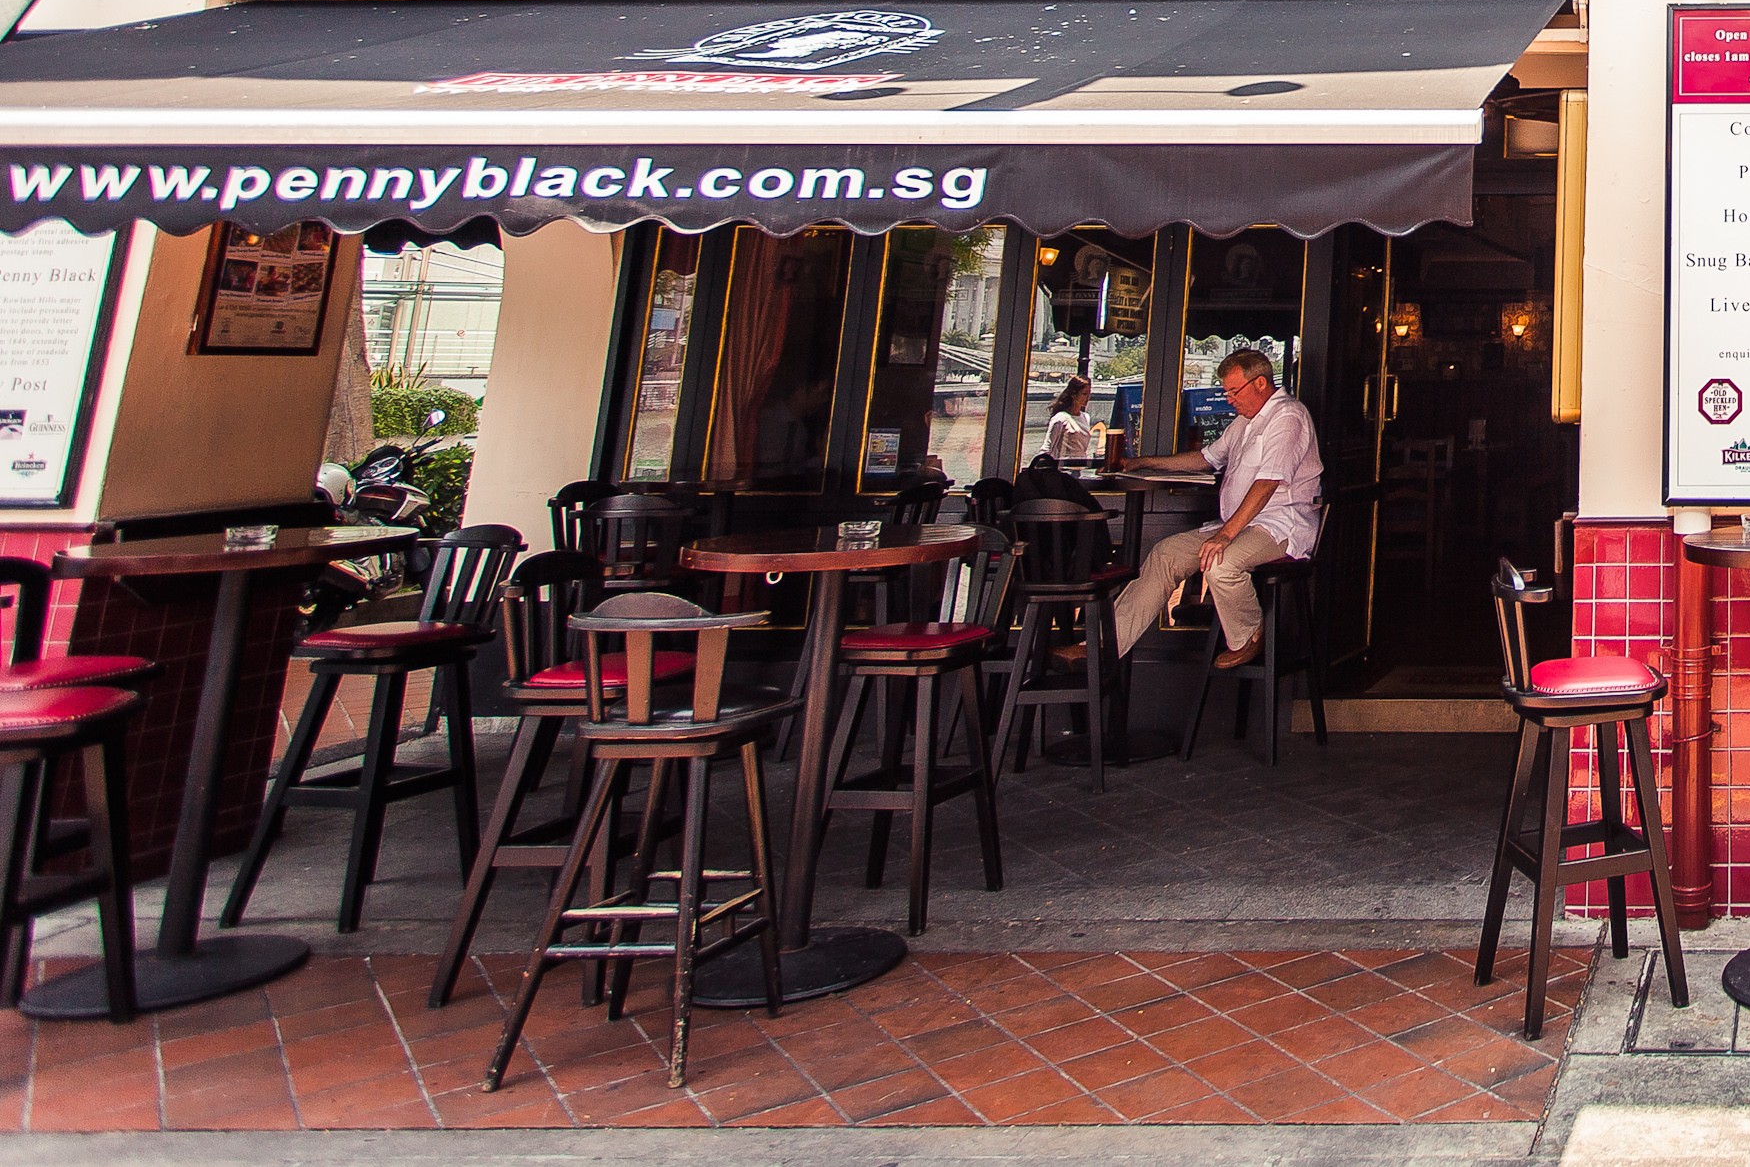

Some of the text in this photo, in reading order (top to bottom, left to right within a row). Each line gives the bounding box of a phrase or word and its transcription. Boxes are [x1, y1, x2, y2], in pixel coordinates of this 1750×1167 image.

[1715, 29, 1748, 43] Open
[1684, 51, 1720, 63] closes
[1725, 50, 1750, 62] 1am
[5, 157, 990, 218] www.pennyblack.com.sg
[1685, 252, 1728, 271] Snug
[49, 268, 96, 283] Black
[1710, 297, 1750, 313] Live
[11, 377, 48, 391] Post
[29, 422, 66, 432] GUINNESS
